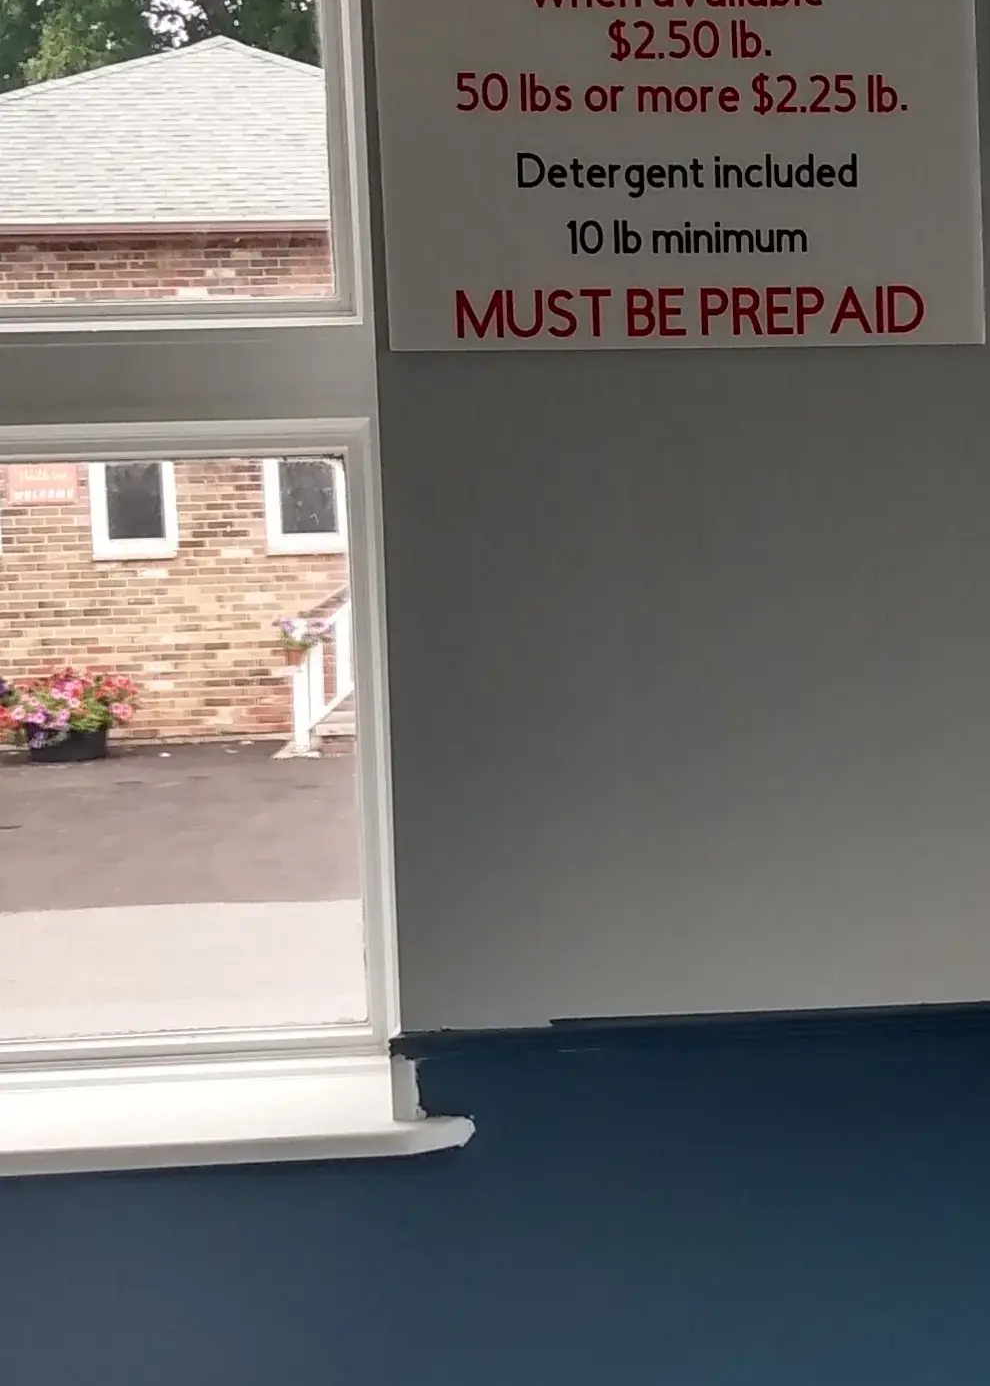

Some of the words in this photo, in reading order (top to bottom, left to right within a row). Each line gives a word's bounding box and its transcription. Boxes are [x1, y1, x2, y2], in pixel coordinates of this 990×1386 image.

[608, 18, 720, 62] $2.50
[731, 19, 772, 59] lb.
[456, 72, 509, 112] 50
[519, 72, 572, 112] lbs
[584, 85, 625, 113] or
[637, 85, 740, 113] more
[751, 72, 857, 116] $2.25
[867, 74, 908, 113] lb.
[516, 152, 705, 199] Detergent
[714, 152, 858, 189] included
[566, 220, 604, 255] 10
[613, 219, 642, 255] lb
[652, 221, 808, 254] minimum
[455, 288, 612, 339] MUST
[626, 287, 687, 337] BE
[700, 285, 925, 336] PREPAID
